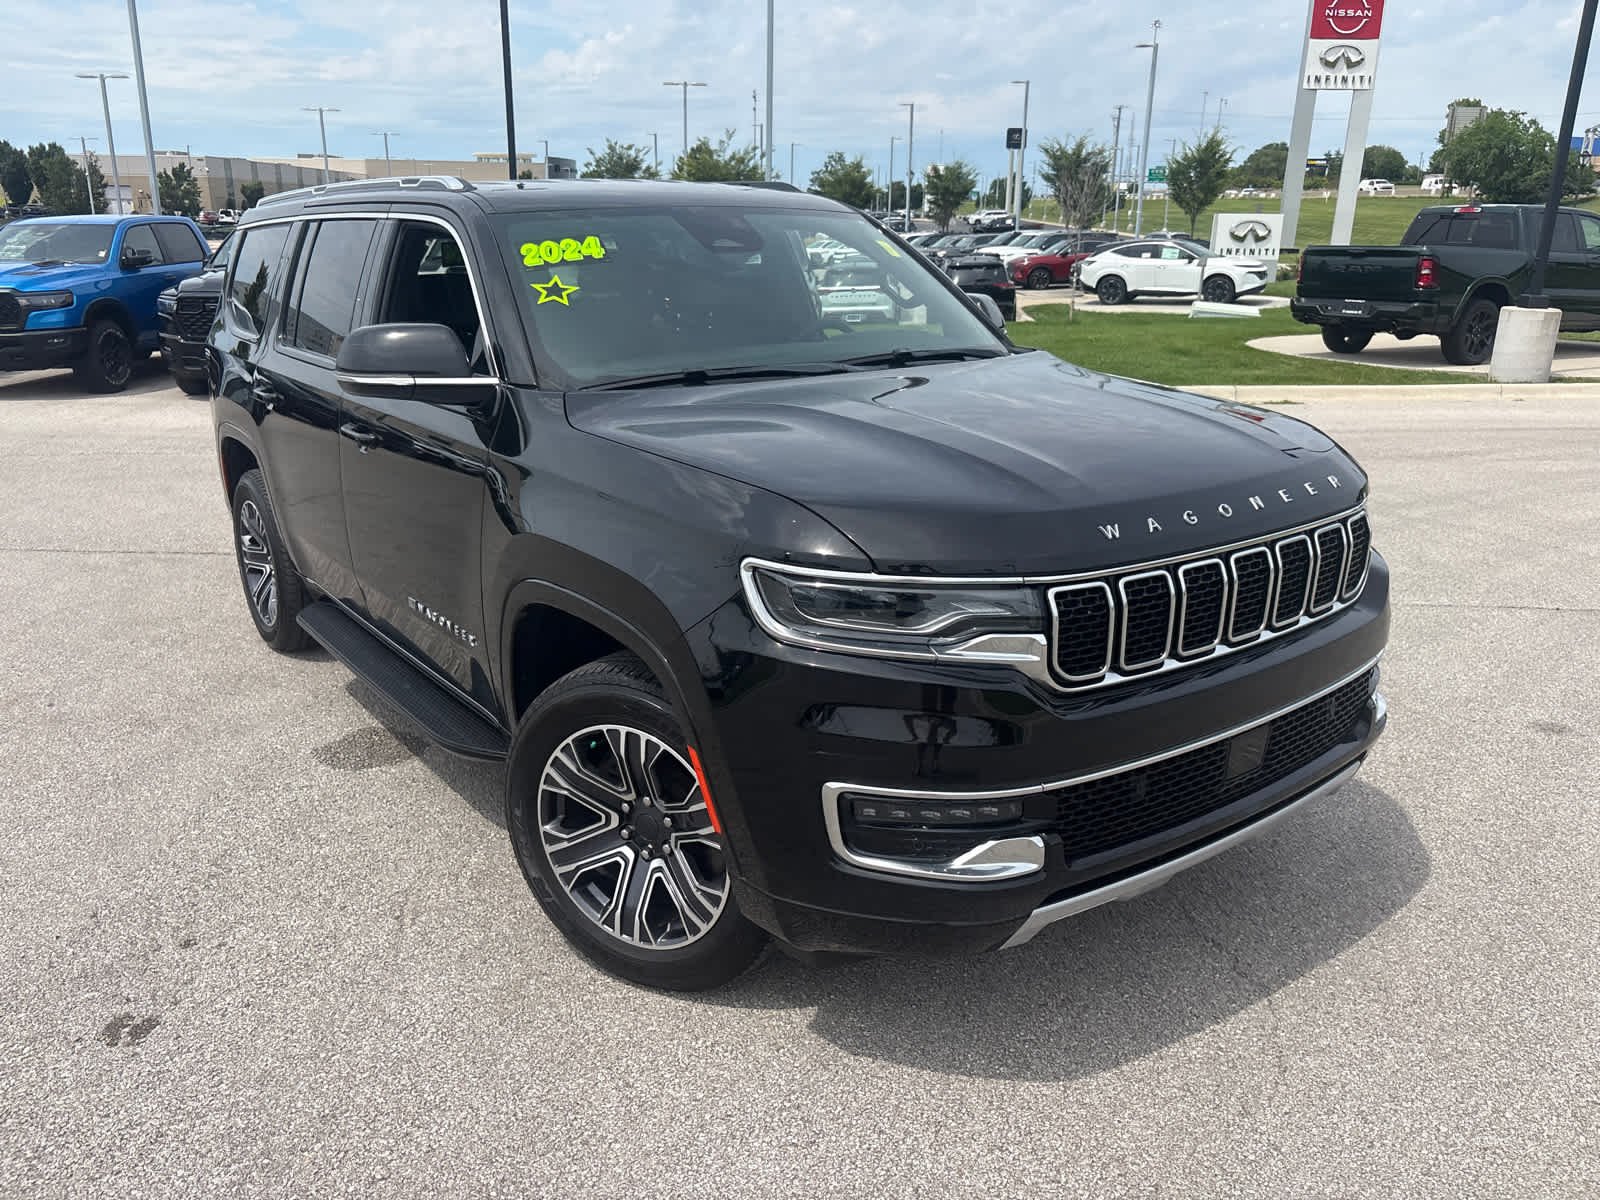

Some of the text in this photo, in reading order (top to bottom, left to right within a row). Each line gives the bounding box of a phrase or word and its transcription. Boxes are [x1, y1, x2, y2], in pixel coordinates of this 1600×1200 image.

[1325, 9, 1372, 17] NISSAN
[1307, 75, 1372, 85] INFINITI
[520, 236, 606, 267] 2024
[1220, 248, 1275, 256] INFINITI
[1099, 475, 1341, 540] WAGONEER
